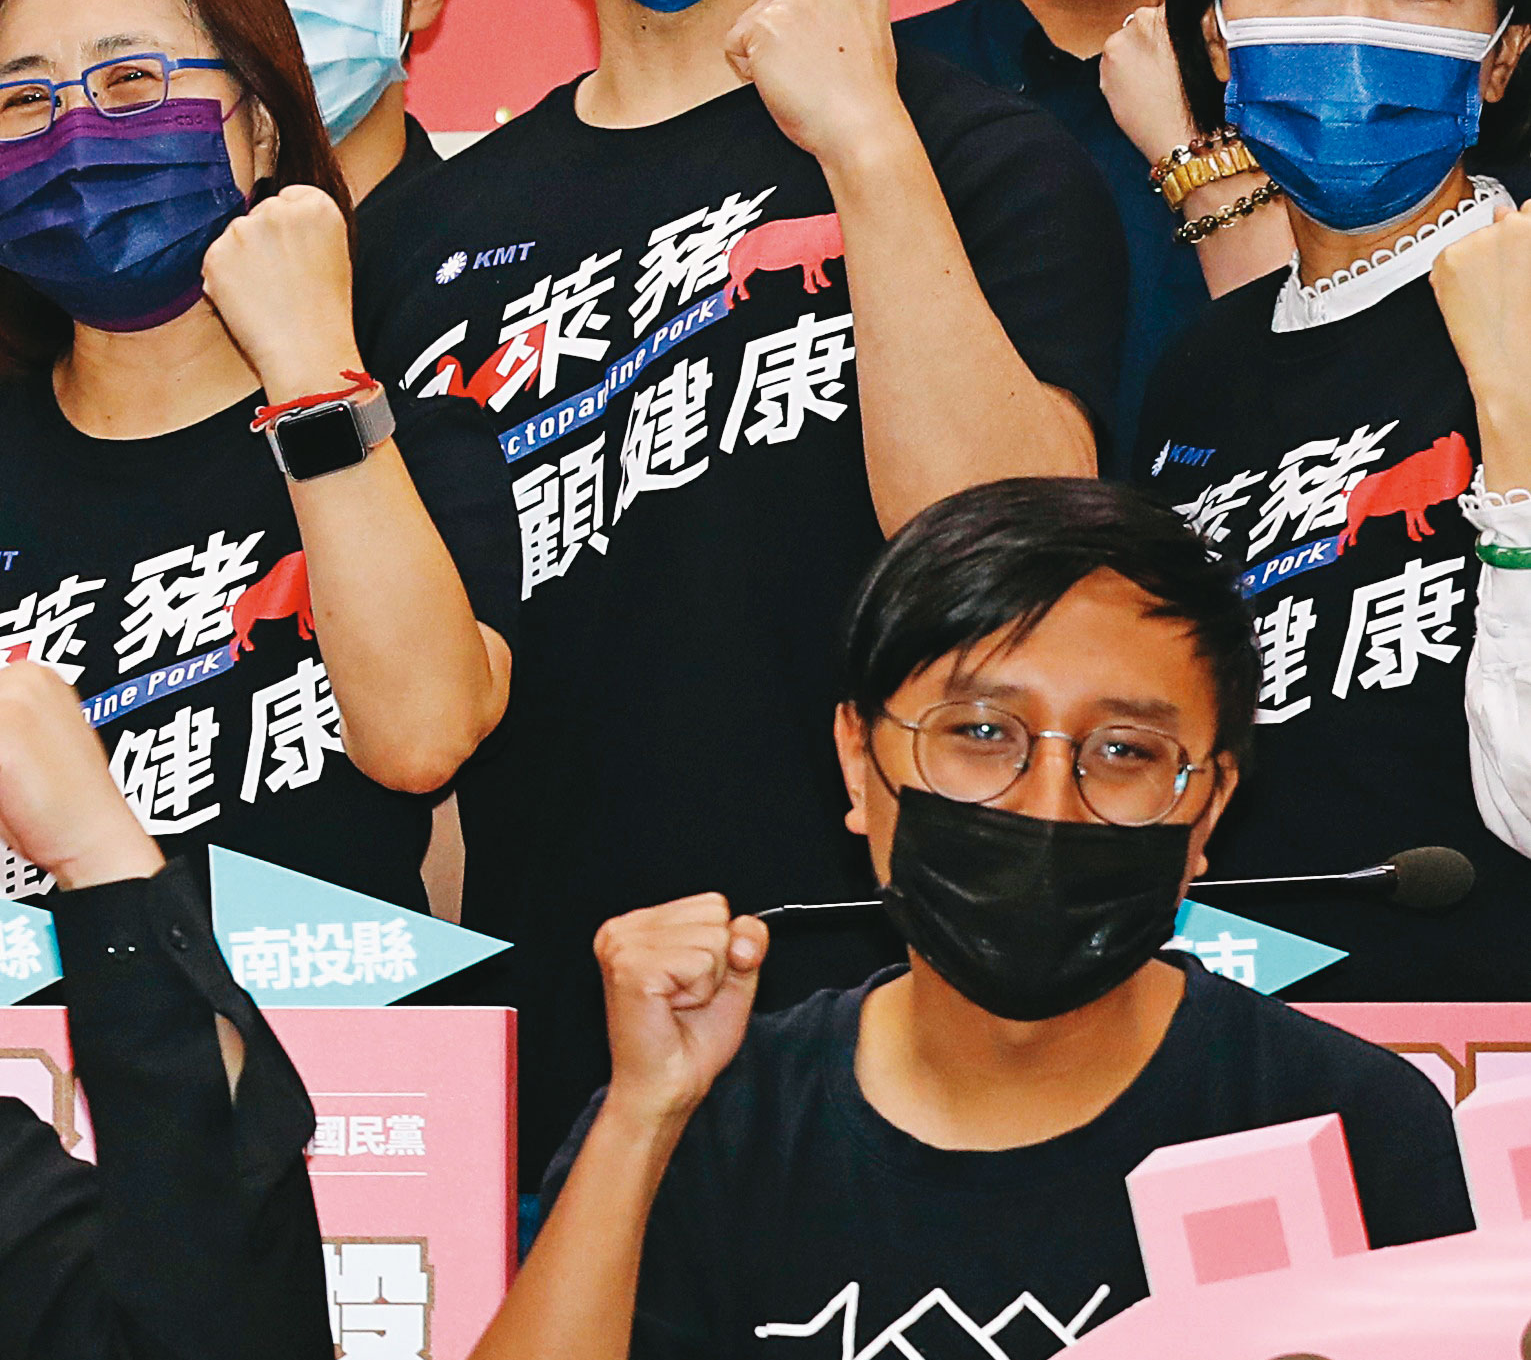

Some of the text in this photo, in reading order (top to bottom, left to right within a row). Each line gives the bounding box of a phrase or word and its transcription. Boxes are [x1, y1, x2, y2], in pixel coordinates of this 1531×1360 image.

[472, 241, 536, 271] KMT
[651, 297, 717, 354] Pork
[511, 312, 856, 602] 顧健康
[1169, 444, 1216, 467] KMT
[1261, 542, 1332, 586] Pork
[147, 649, 221, 699] Pork
[228, 917, 419, 992] 南投縣
